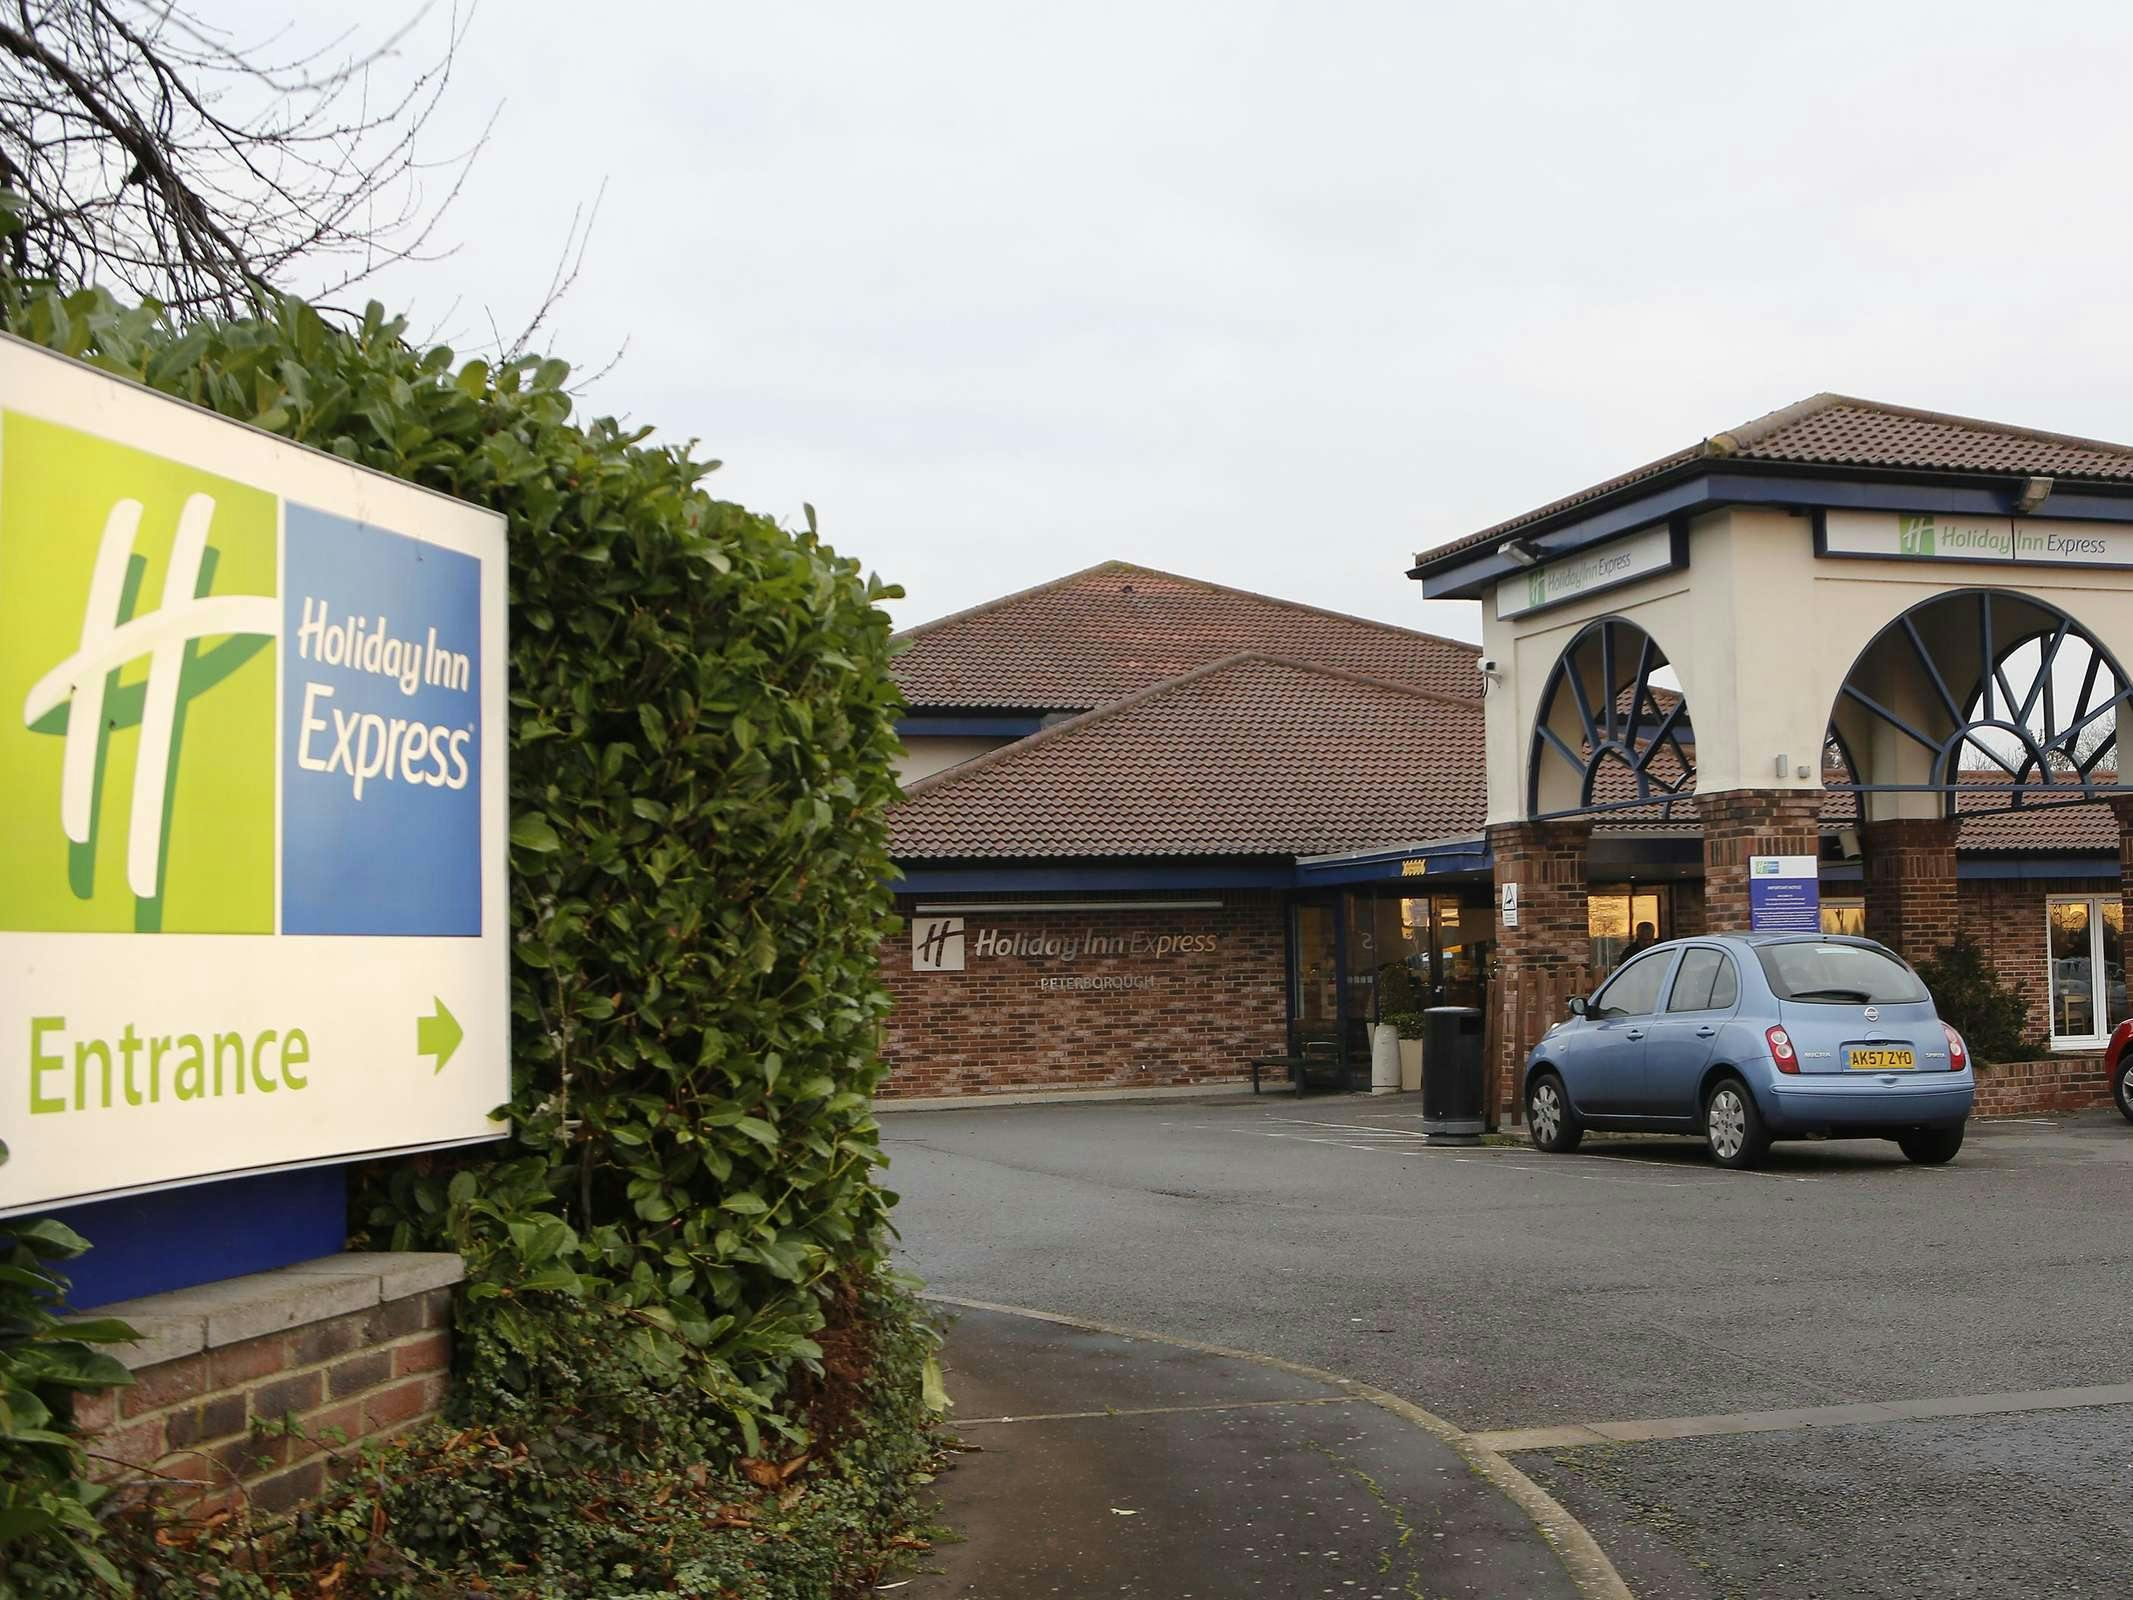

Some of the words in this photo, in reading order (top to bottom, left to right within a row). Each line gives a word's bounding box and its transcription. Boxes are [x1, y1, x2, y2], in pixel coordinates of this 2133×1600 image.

[1941, 526, 2012, 553] Holiday
[2016, 530, 2044, 551] Inn
[2047, 534, 2106, 556] Express
[1548, 569, 1582, 592] Holiday
[1599, 552, 1632, 578] Express
[297, 596, 422, 696] Holiday
[424, 627, 470, 693] Inn
[298, 681, 471, 801] Express
[975, 928, 1080, 961] Holiday
[1083, 928, 1125, 955] Inn
[1130, 930, 1217, 959] Express
[1040, 975, 1155, 992] PETERBOROUGH
[30, 1016, 311, 1115] Entrance
[1852, 1051, 1884, 1066] AK57
[1888, 1051, 1912, 1065] ZYO
